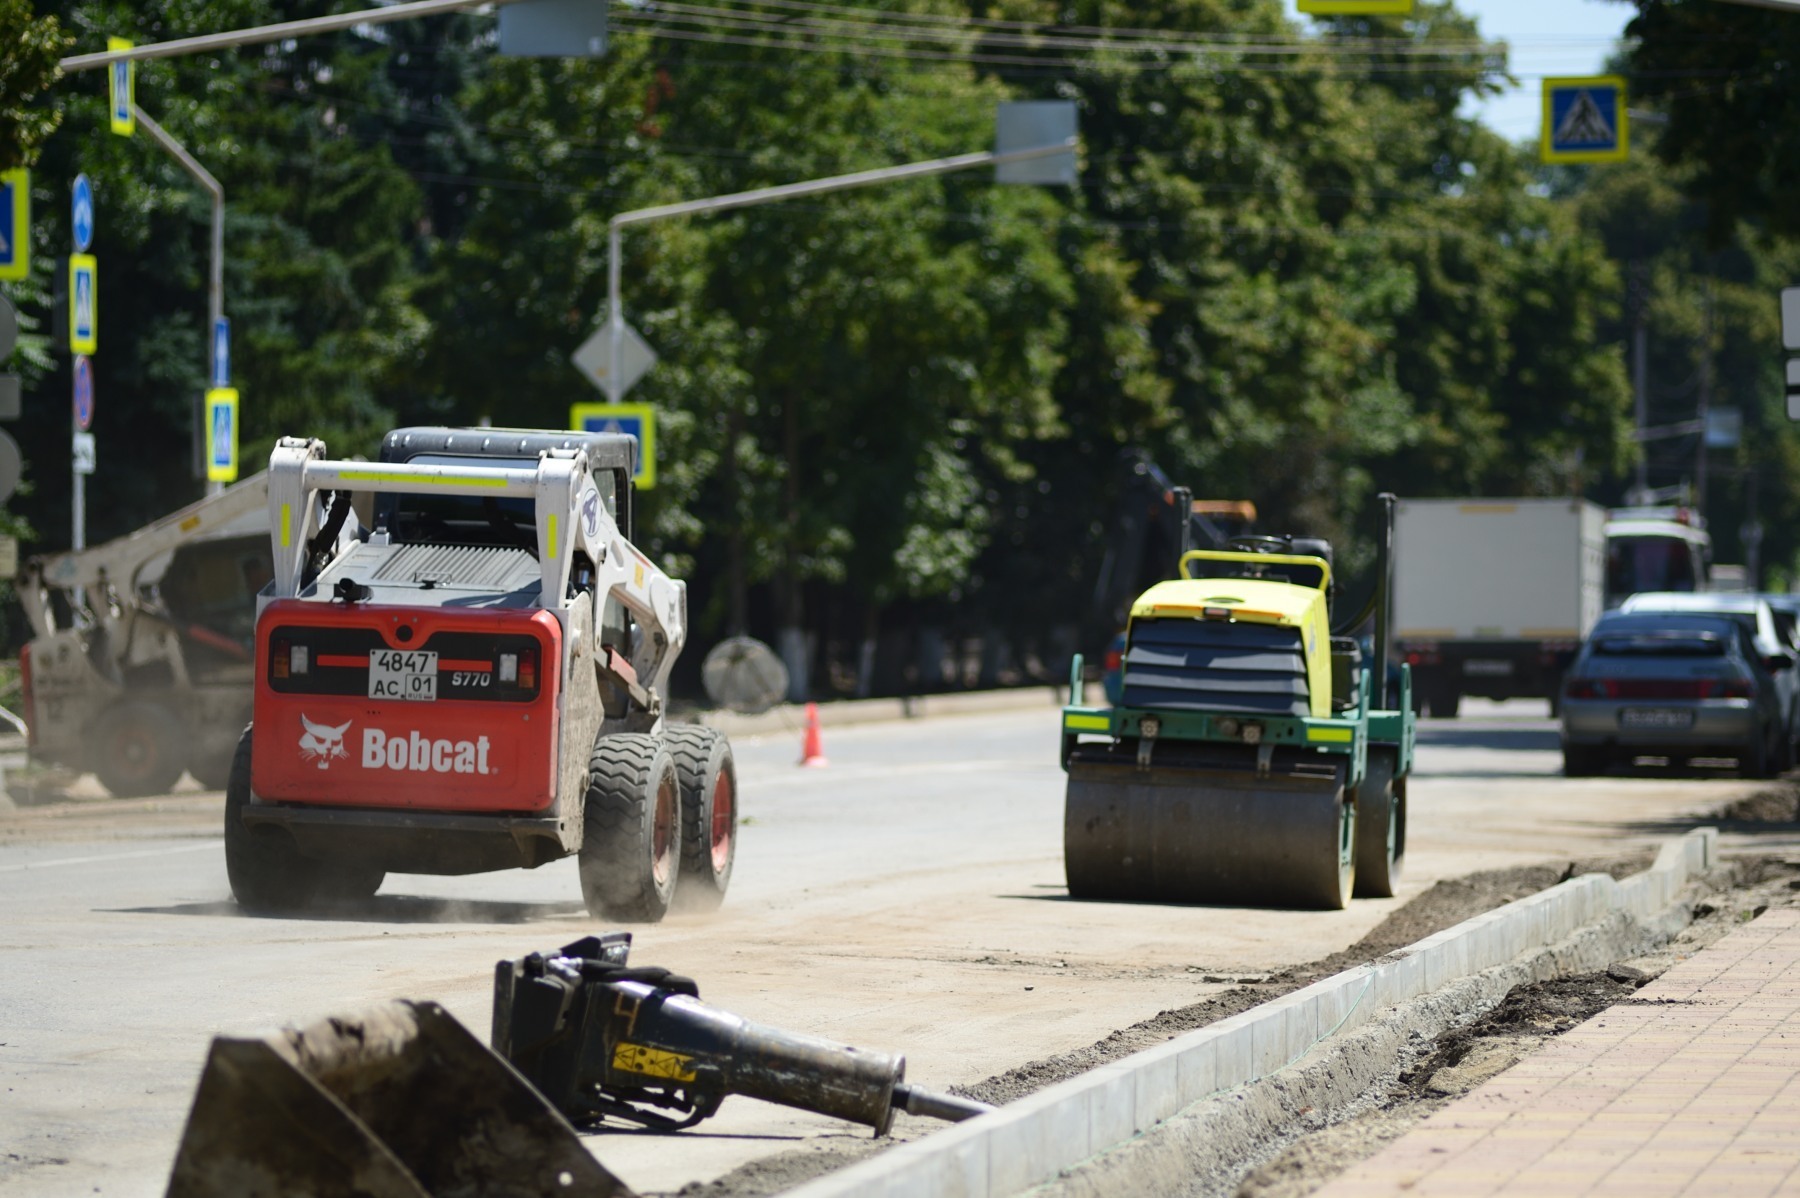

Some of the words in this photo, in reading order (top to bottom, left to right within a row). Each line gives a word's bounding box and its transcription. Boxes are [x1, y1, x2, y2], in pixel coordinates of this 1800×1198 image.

[378, 652, 430, 673] 4847
[412, 677, 432, 693] 01
[451, 671, 491, 687] S770
[361, 727, 490, 775] Bobcat
